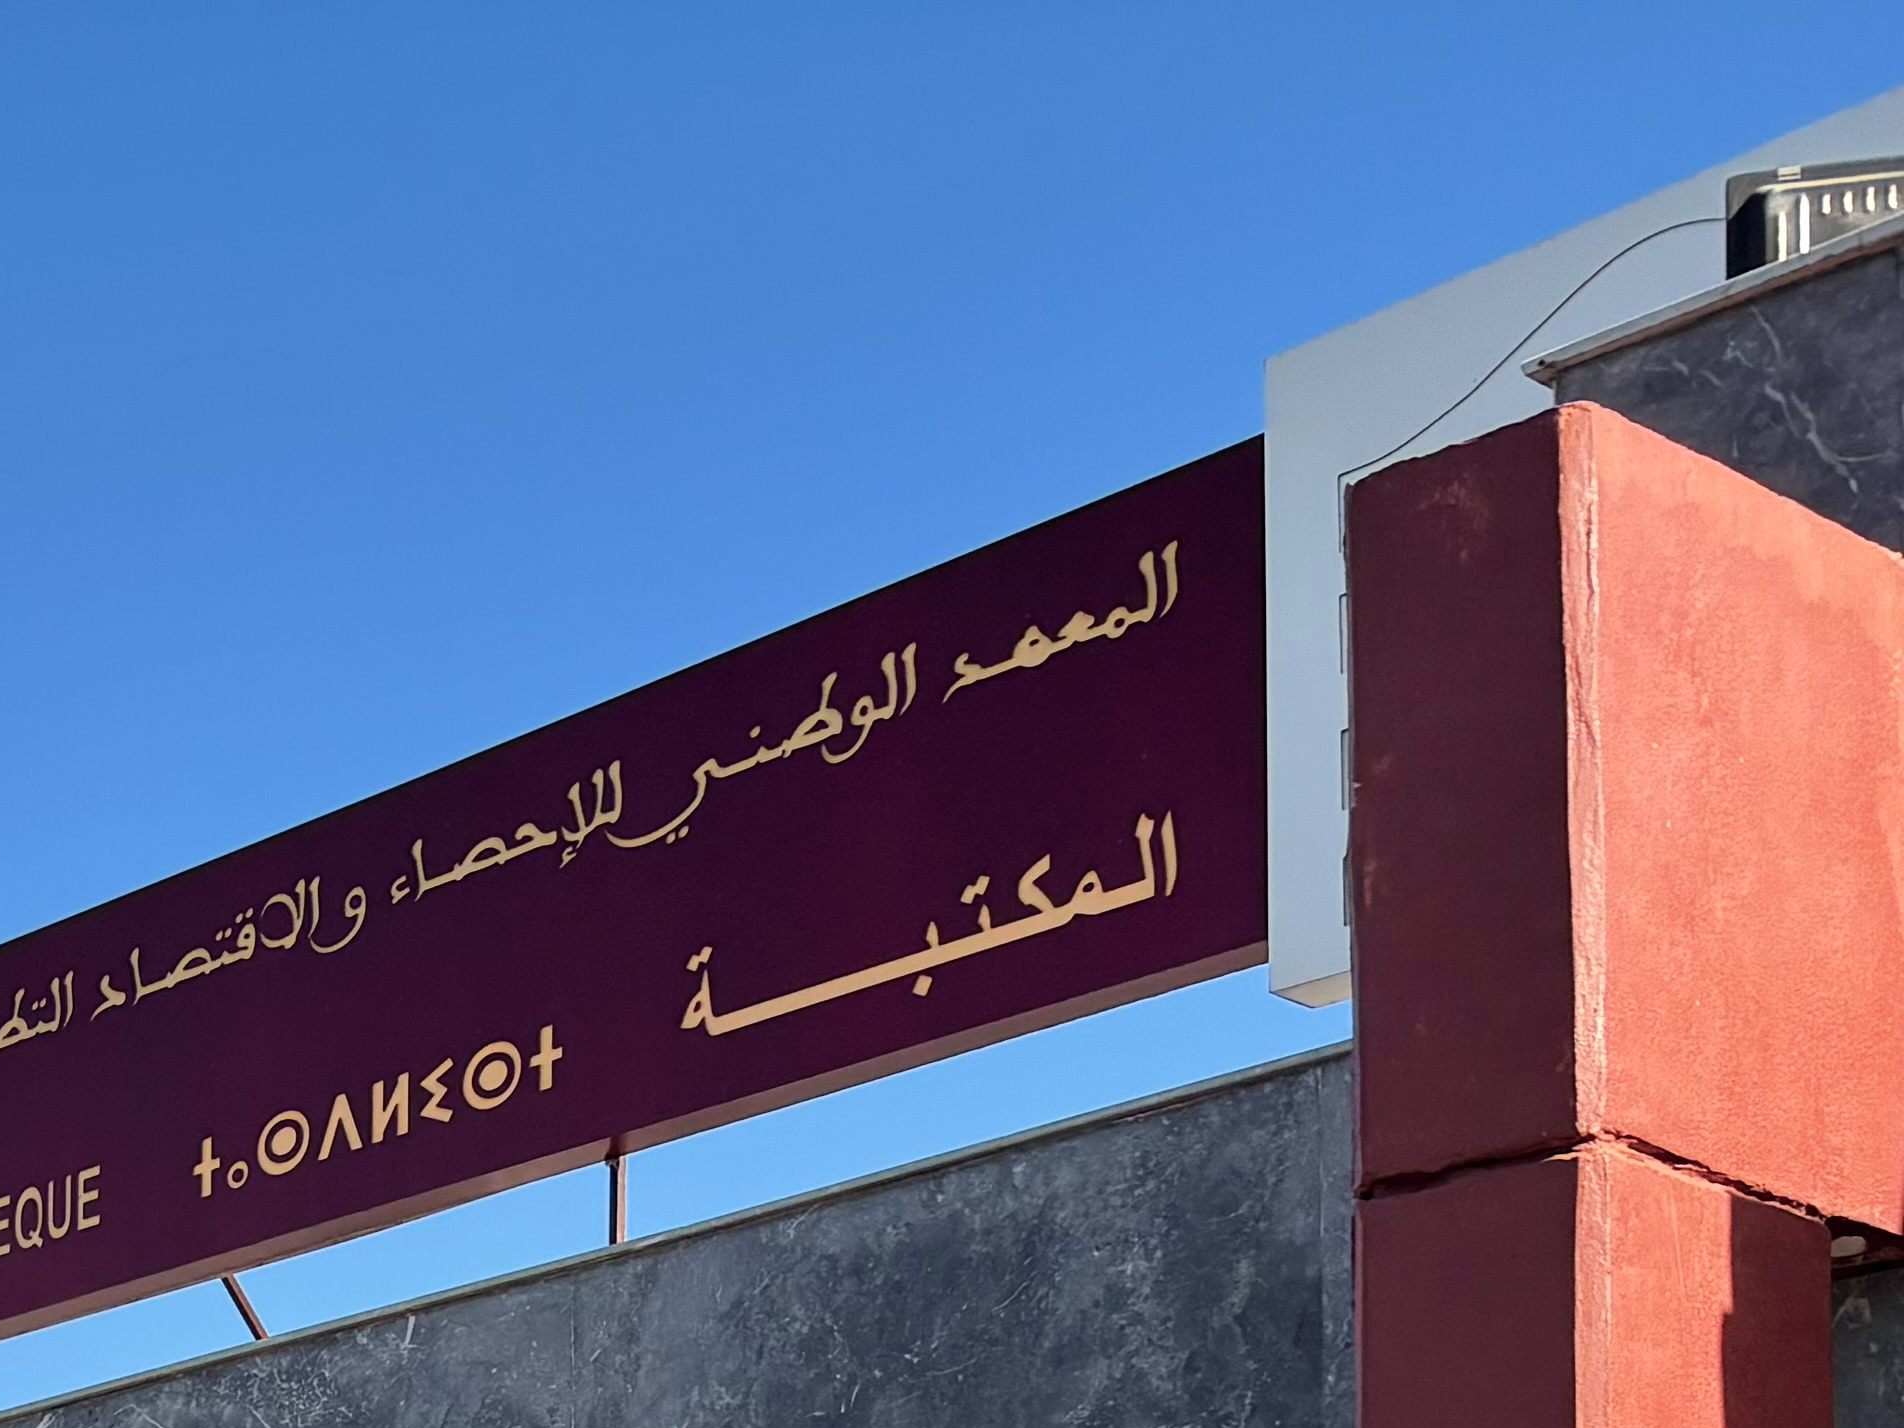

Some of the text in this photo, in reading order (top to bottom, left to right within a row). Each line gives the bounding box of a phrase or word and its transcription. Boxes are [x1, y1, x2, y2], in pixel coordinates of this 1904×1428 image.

[943, 540, 1178, 703] المعهد
[390, 760, 623, 904] للإحصاء
[604, 642, 917, 848] الوطني
[680, 811, 1177, 1036] المكتبة
